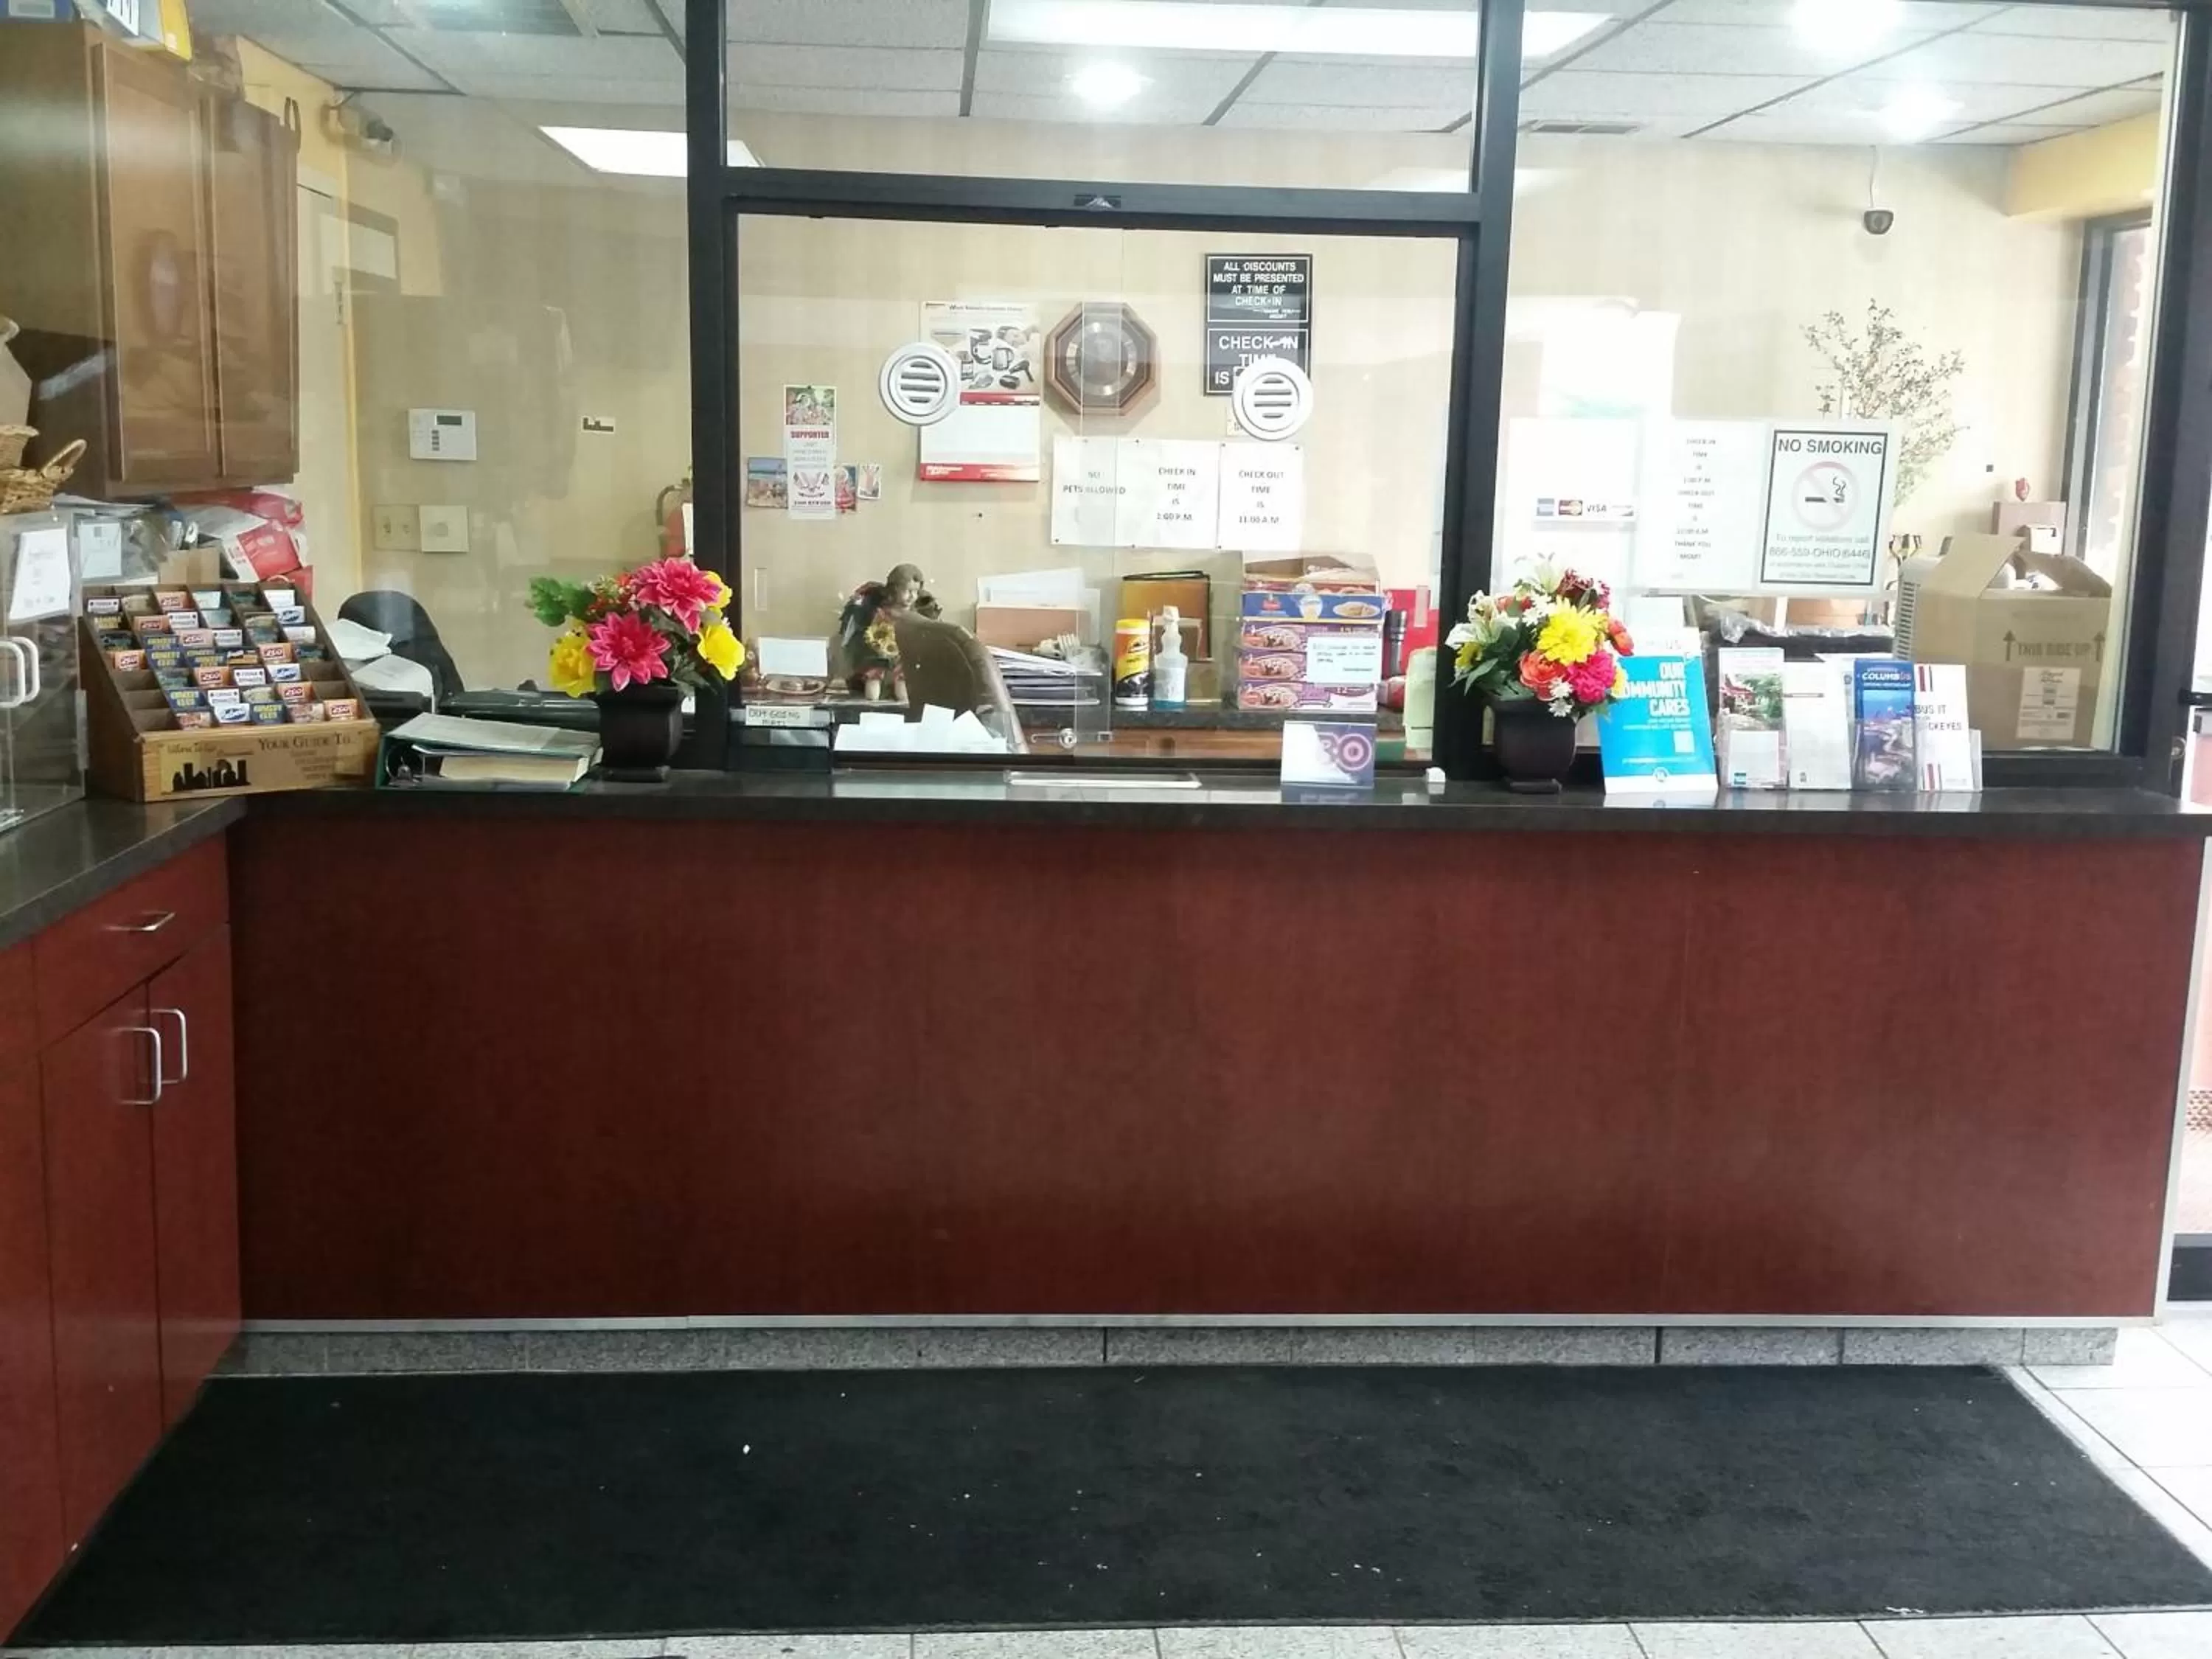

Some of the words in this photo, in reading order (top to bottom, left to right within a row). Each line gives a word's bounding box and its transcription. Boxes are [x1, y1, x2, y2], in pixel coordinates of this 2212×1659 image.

[1223, 262, 1239, 271] ALL
[1243, 261, 1295, 271] DISCOUNTS
[1213, 274, 1237, 282] MUST
[1240, 274, 1251, 282] BE
[1254, 274, 1304, 282] PRESENTED
[1231, 285, 1242, 294] AT
[1247, 285, 1268, 294] TIME
[1273, 285, 1287, 294] OF
[1235, 296, 1282, 306] CHECK-IN
[1214, 371, 1229, 384] IS
[1778, 439, 1801, 452] NO
[1806, 439, 1882, 455] SMOKING
[1158, 467, 1184, 476] CHECK
[1238, 470, 1265, 479] CHECK
[1062, 484, 1082, 493] PETS
[1084, 485, 1127, 494] ALLOWED
[1586, 504, 1607, 512] VISA
[1660, 662, 1685, 679] OUR
[1621, 680, 1687, 698] OMMUNITY
[1649, 699, 1690, 717] CARES
[258, 737, 289, 751] YOUR
